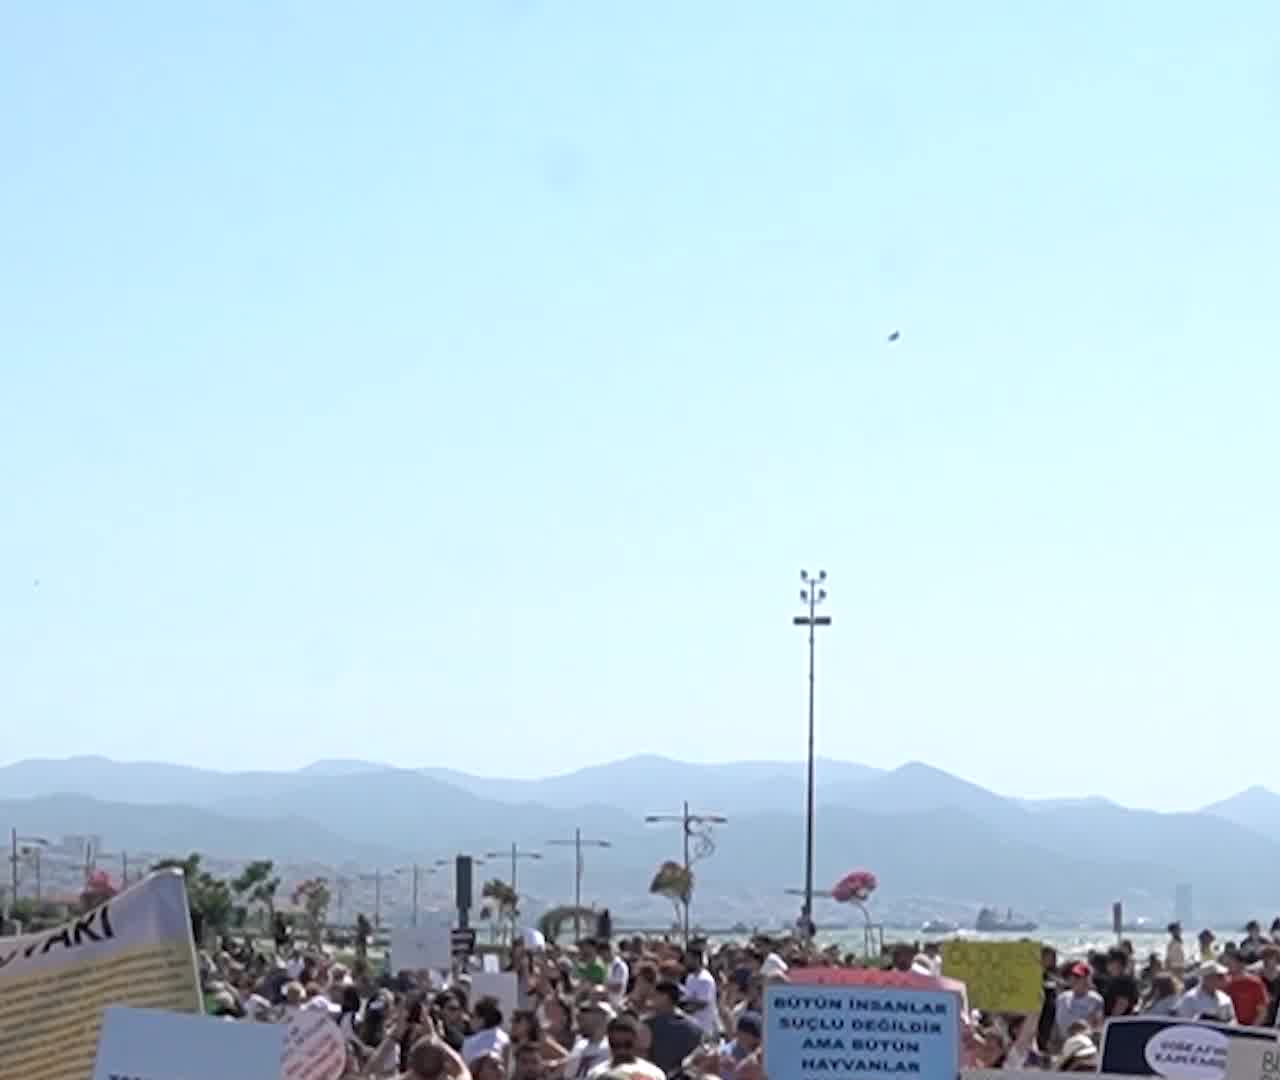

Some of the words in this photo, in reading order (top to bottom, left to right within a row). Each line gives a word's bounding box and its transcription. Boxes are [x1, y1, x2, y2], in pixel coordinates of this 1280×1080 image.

[774, 997, 842, 1011] BÜTÜN
[849, 999, 947, 1016] İNSANLAR
[779, 1017, 845, 1032] SUÇLU
[852, 1018, 942, 1035] DEĞİLDİR
[802, 1037, 845, 1050] AMA
[852, 1039, 919, 1052] BÜTÜN
[801, 1058, 920, 1073] HAYVANLAR
